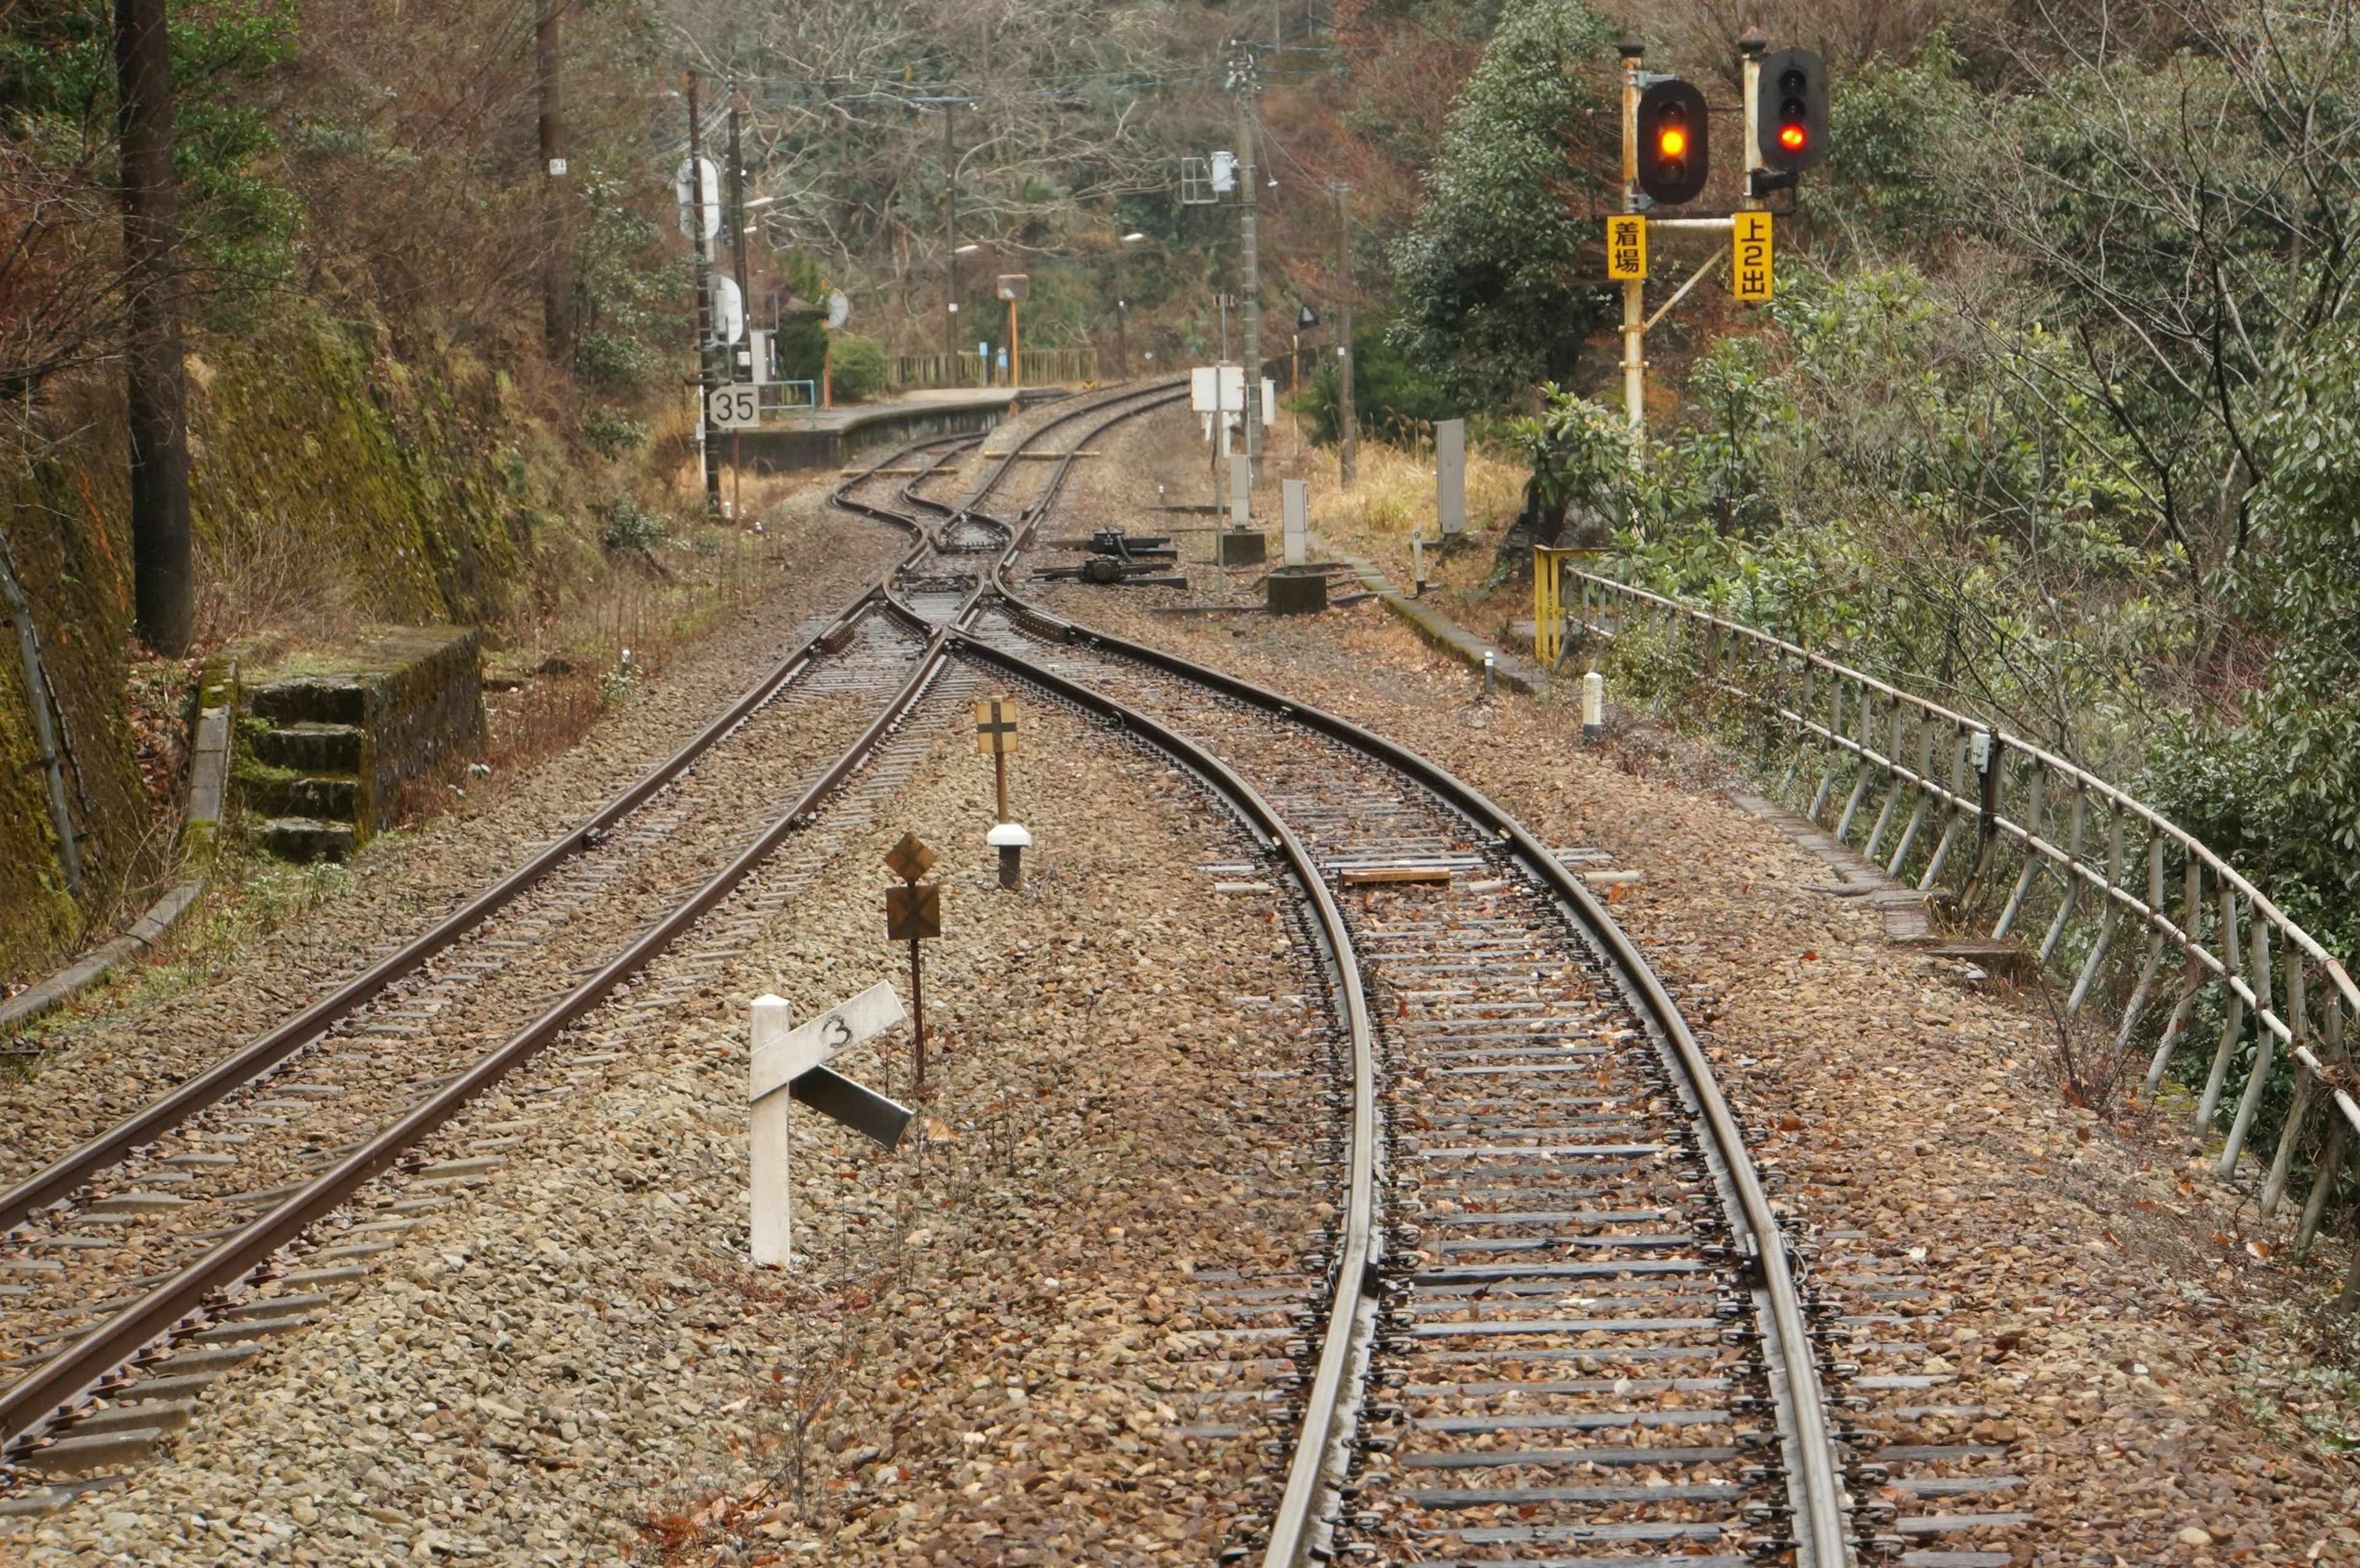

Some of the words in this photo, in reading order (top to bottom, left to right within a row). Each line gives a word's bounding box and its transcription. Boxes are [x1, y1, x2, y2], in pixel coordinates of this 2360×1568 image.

[1615, 222, 1640, 273] 着場
[1740, 218, 1766, 295] 上2出
[716, 392, 753, 421] 35
[822, 1014, 853, 1049] 3
